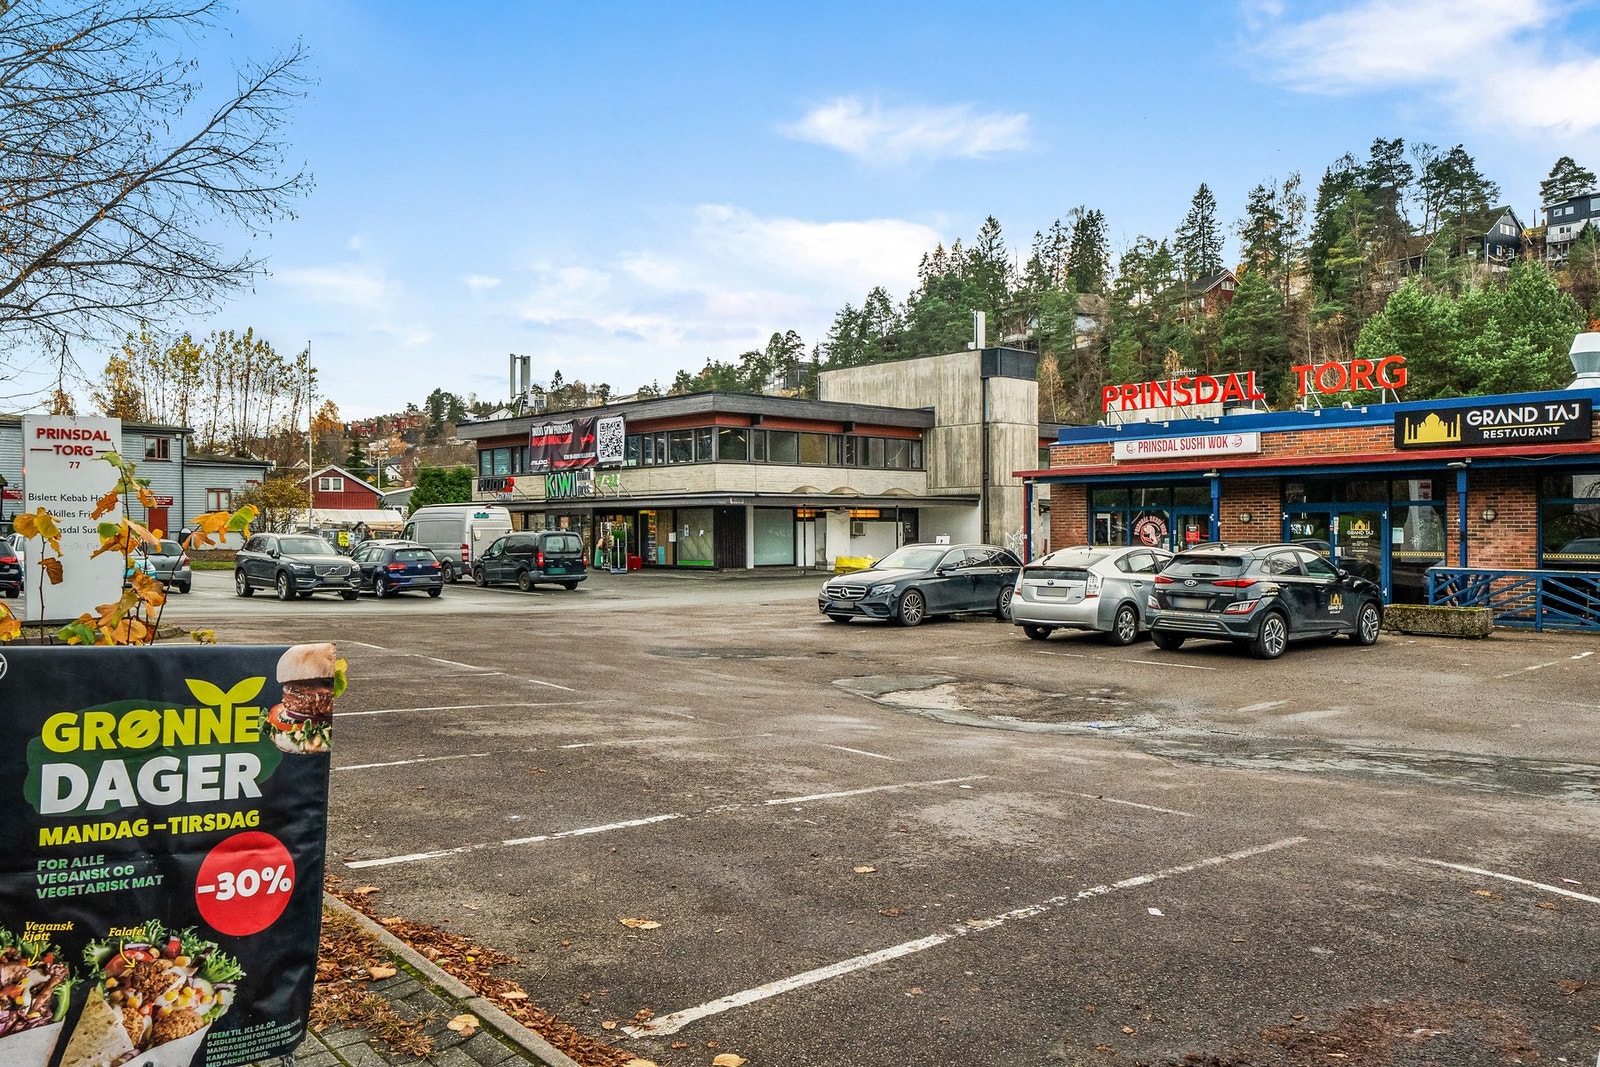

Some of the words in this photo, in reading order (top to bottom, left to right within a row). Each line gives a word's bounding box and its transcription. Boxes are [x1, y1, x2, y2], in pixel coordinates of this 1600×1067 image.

[1102, 371, 1266, 414] PRINSDAL
[1292, 355, 1407, 396] TORG
[1466, 406, 1539, 426] GRAND
[1545, 403, 1580, 421] TAJ
[36, 427, 112, 441] PRINSDAL
[1483, 427, 1560, 439] RESTAURANT
[53, 444, 94, 456] TORG
[1138, 438, 1178, 453] PRINSDAL
[1180, 437, 1206, 451] SUSHI
[1208, 435, 1229, 449] WOK
[69, 461, 81, 469] 77
[545, 472, 576, 497] KIWI
[28, 493, 57, 502] Bislett
[60, 494, 88, 502] Kebab
[47, 510, 76, 518] Akilles
[41, 706, 261, 753] GRØNNE
[39, 752, 263, 815] DAGER
[38, 818, 149, 847] MANDAG
[37, 859, 68, 871] FOR
[70, 854, 105, 869] ALLE
[36, 868, 110, 885] VEGANSK
[112, 865, 135, 877] OG
[36, 881, 134, 899] VEGETARISK
[135, 874, 165, 890] MAT
[24, 920, 75, 935] Vegansk
[108, 925, 147, 938] Falafel
[22, 931, 52, 943] kjøtt
[208, 1030, 230, 1040] FREM
[254, 1020, 276, 1031] 24.00
[206, 1042, 247, 1054] MANDAGER
[206, 1048, 250, 1062] KAMPANJEN
[250, 1044, 265, 1053] KAN
[266, 1040, 280, 1050] IKKE
